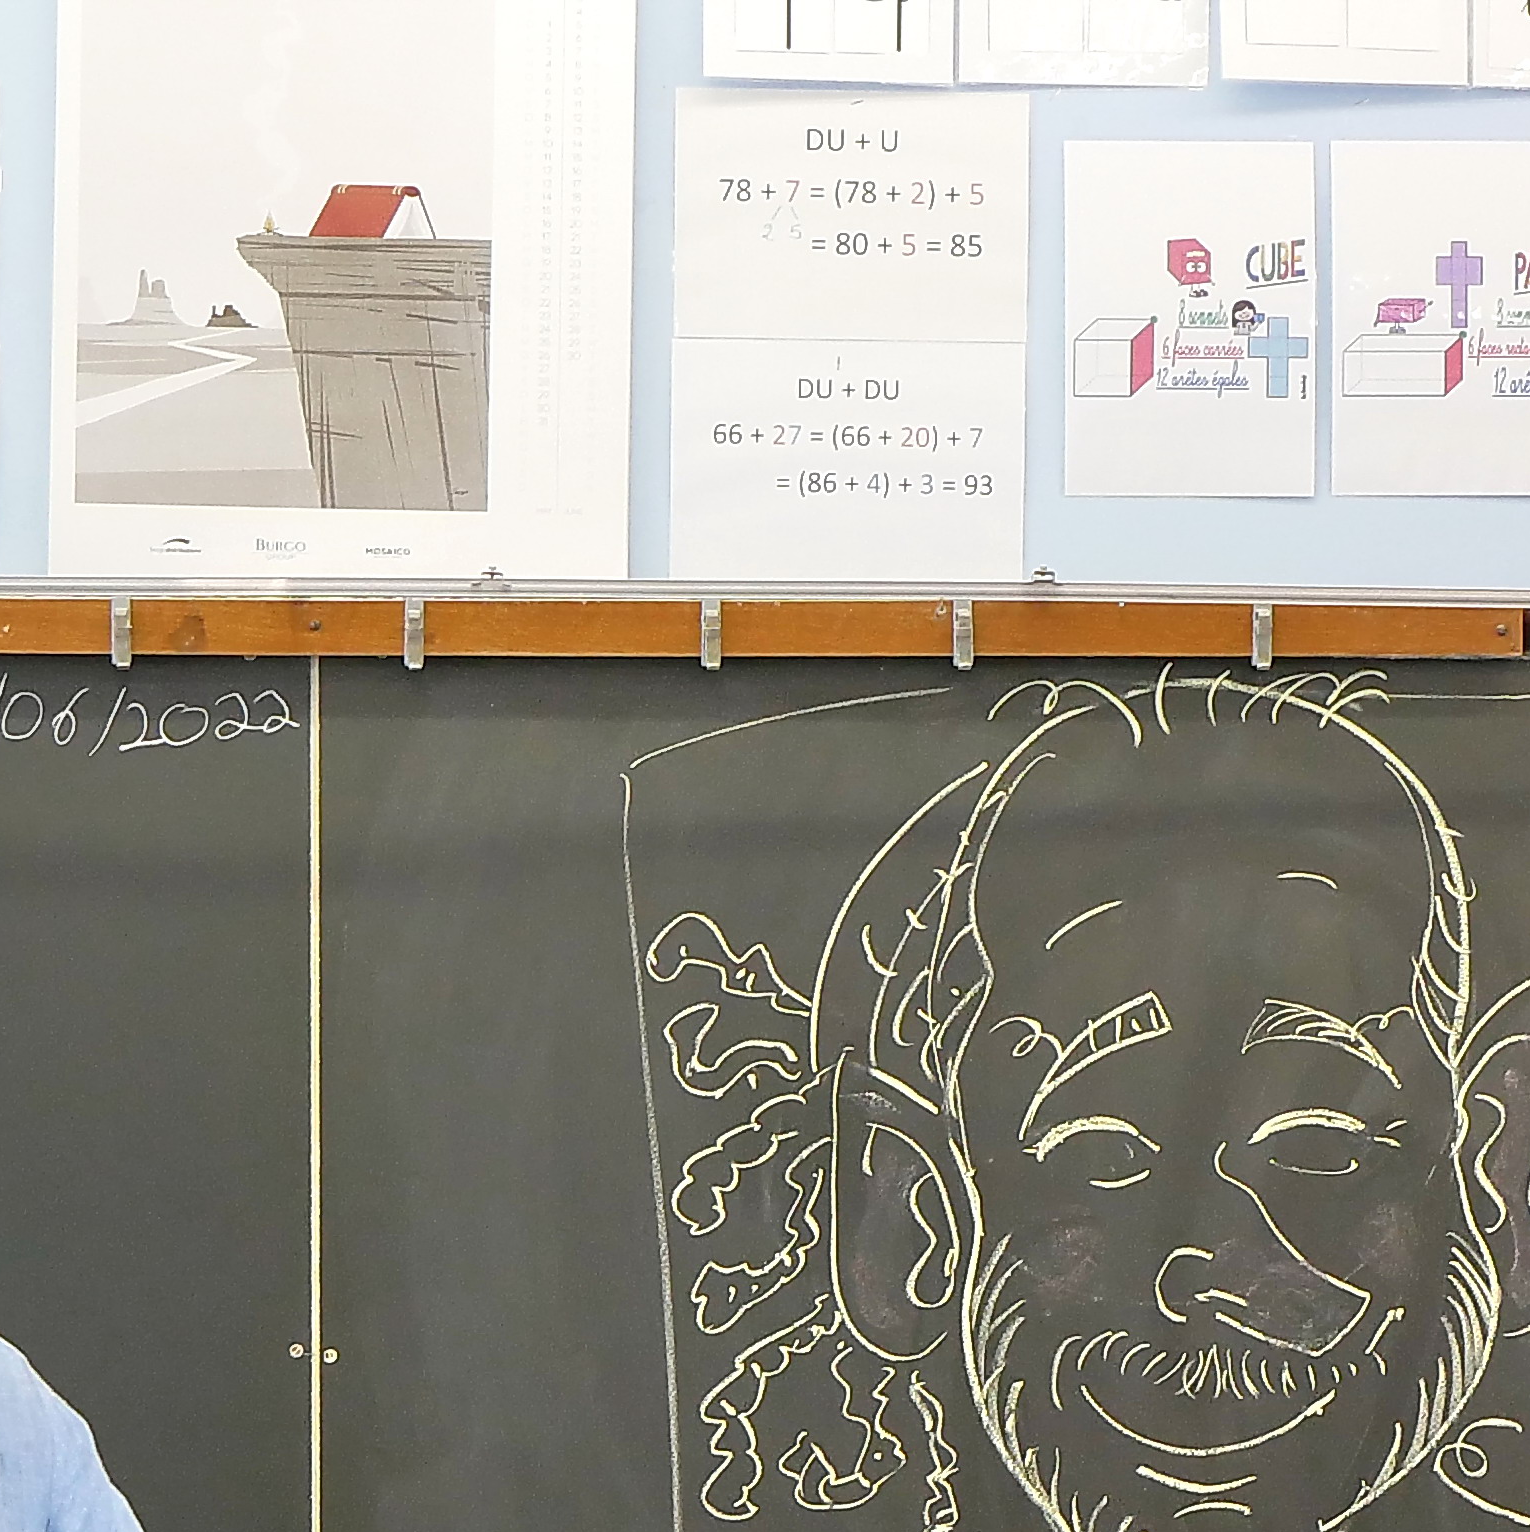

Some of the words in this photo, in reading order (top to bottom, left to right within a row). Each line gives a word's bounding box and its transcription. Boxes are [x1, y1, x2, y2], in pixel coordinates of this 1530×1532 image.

[806, 128, 845, 152] DU
[854, 133, 871, 151] +
[881, 129, 899, 153] U
[718, 178, 752, 203] 78
[760, 183, 777, 200] +
[785, 179, 801, 203] 7
[809, 187, 826, 198] =
[834, 178, 877, 210] (78
[885, 185, 902, 203] +
[910, 179, 936, 211] 2)
[944, 186, 961, 203] +
[969, 183, 985, 206] 5
[811, 239, 827, 250] =
[835, 232, 869, 256] 80
[877, 237, 893, 255] +
[901, 233, 916, 257] 5
[926, 241, 942, 252] =
[950, 233, 983, 258] 85
[1246, 239, 1305, 282] CUBE
[1162, 336, 1170, 356] 6
[797, 377, 833, 400] DU
[840, 382, 856, 399] +
[864, 379, 900, 401] DU
[1156, 367, 1169, 387] 12
[1493, 366, 1507, 394] 12
[713, 423, 743, 445] 66
[749, 427, 765, 444] +
[772, 424, 802, 446] 27
[809, 431, 824, 442] =
[832, 423, 871, 452] (66
[877, 429, 893, 446] +
[900, 425, 938, 453] 20)
[946, 431, 962, 447] +
[969, 427, 983, 449] 7
[776, 478, 791, 488] =
[799, 469, 837, 498] (86
[844, 476, 860, 492] +
[866, 471, 890, 499] 4)
[897, 477, 913, 493] +
[920, 473, 934, 495] 3
[942, 480, 956, 491] =
[964, 474, 993, 496] 93
